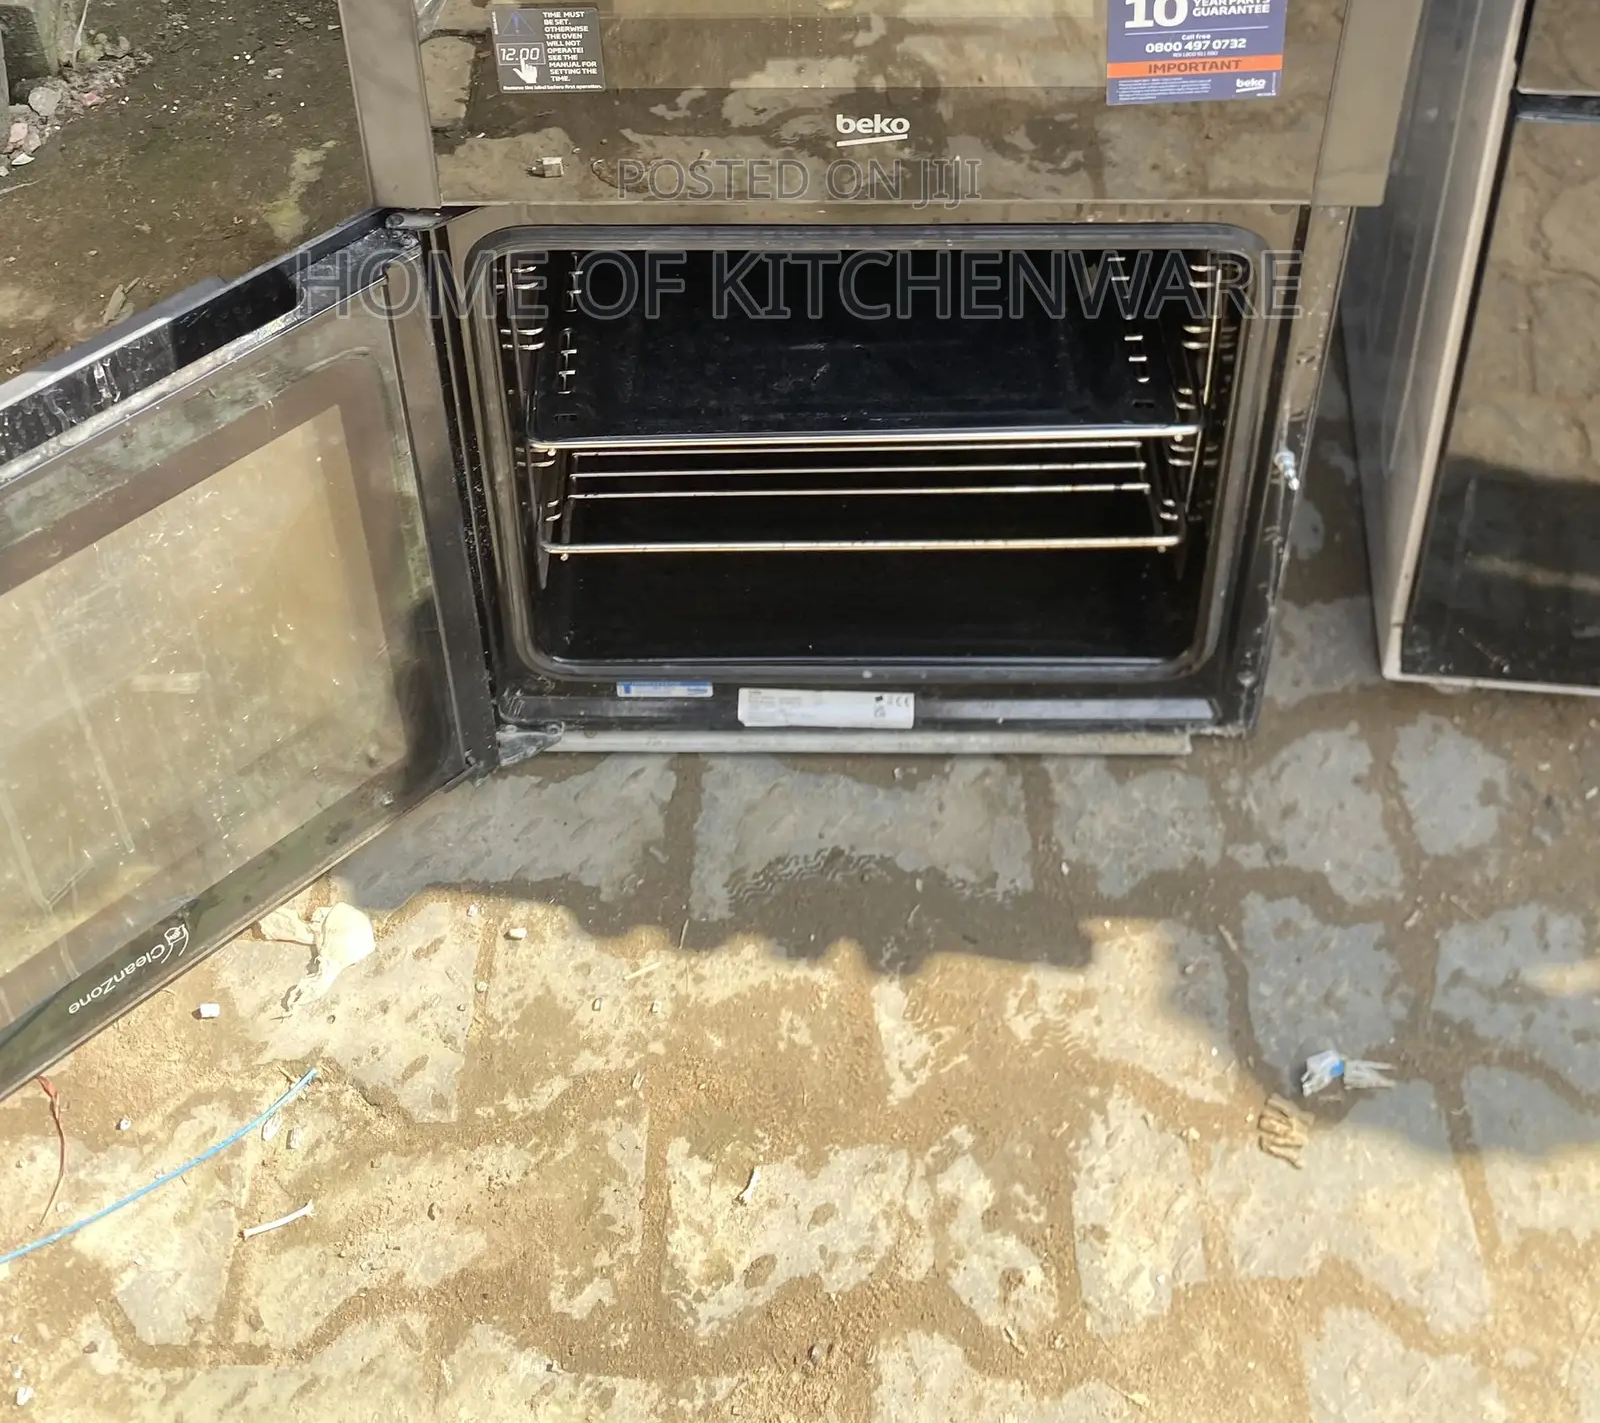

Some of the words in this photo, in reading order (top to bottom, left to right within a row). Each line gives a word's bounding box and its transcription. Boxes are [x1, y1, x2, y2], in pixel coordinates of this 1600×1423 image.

[1192, 4, 1270, 17] GUARANTEE
[1145, 42, 1182, 53] 0800
[1183, 40, 1211, 51] 497
[1211, 38, 1247, 50] 0732
[500, 47, 541, 61] 12.00
[1148, 59, 1243, 75] IMPORTANT
[1236, 77, 1267, 88] beko
[836, 113, 910, 134] beko
[68, 943, 166, 1015] CleanZone
